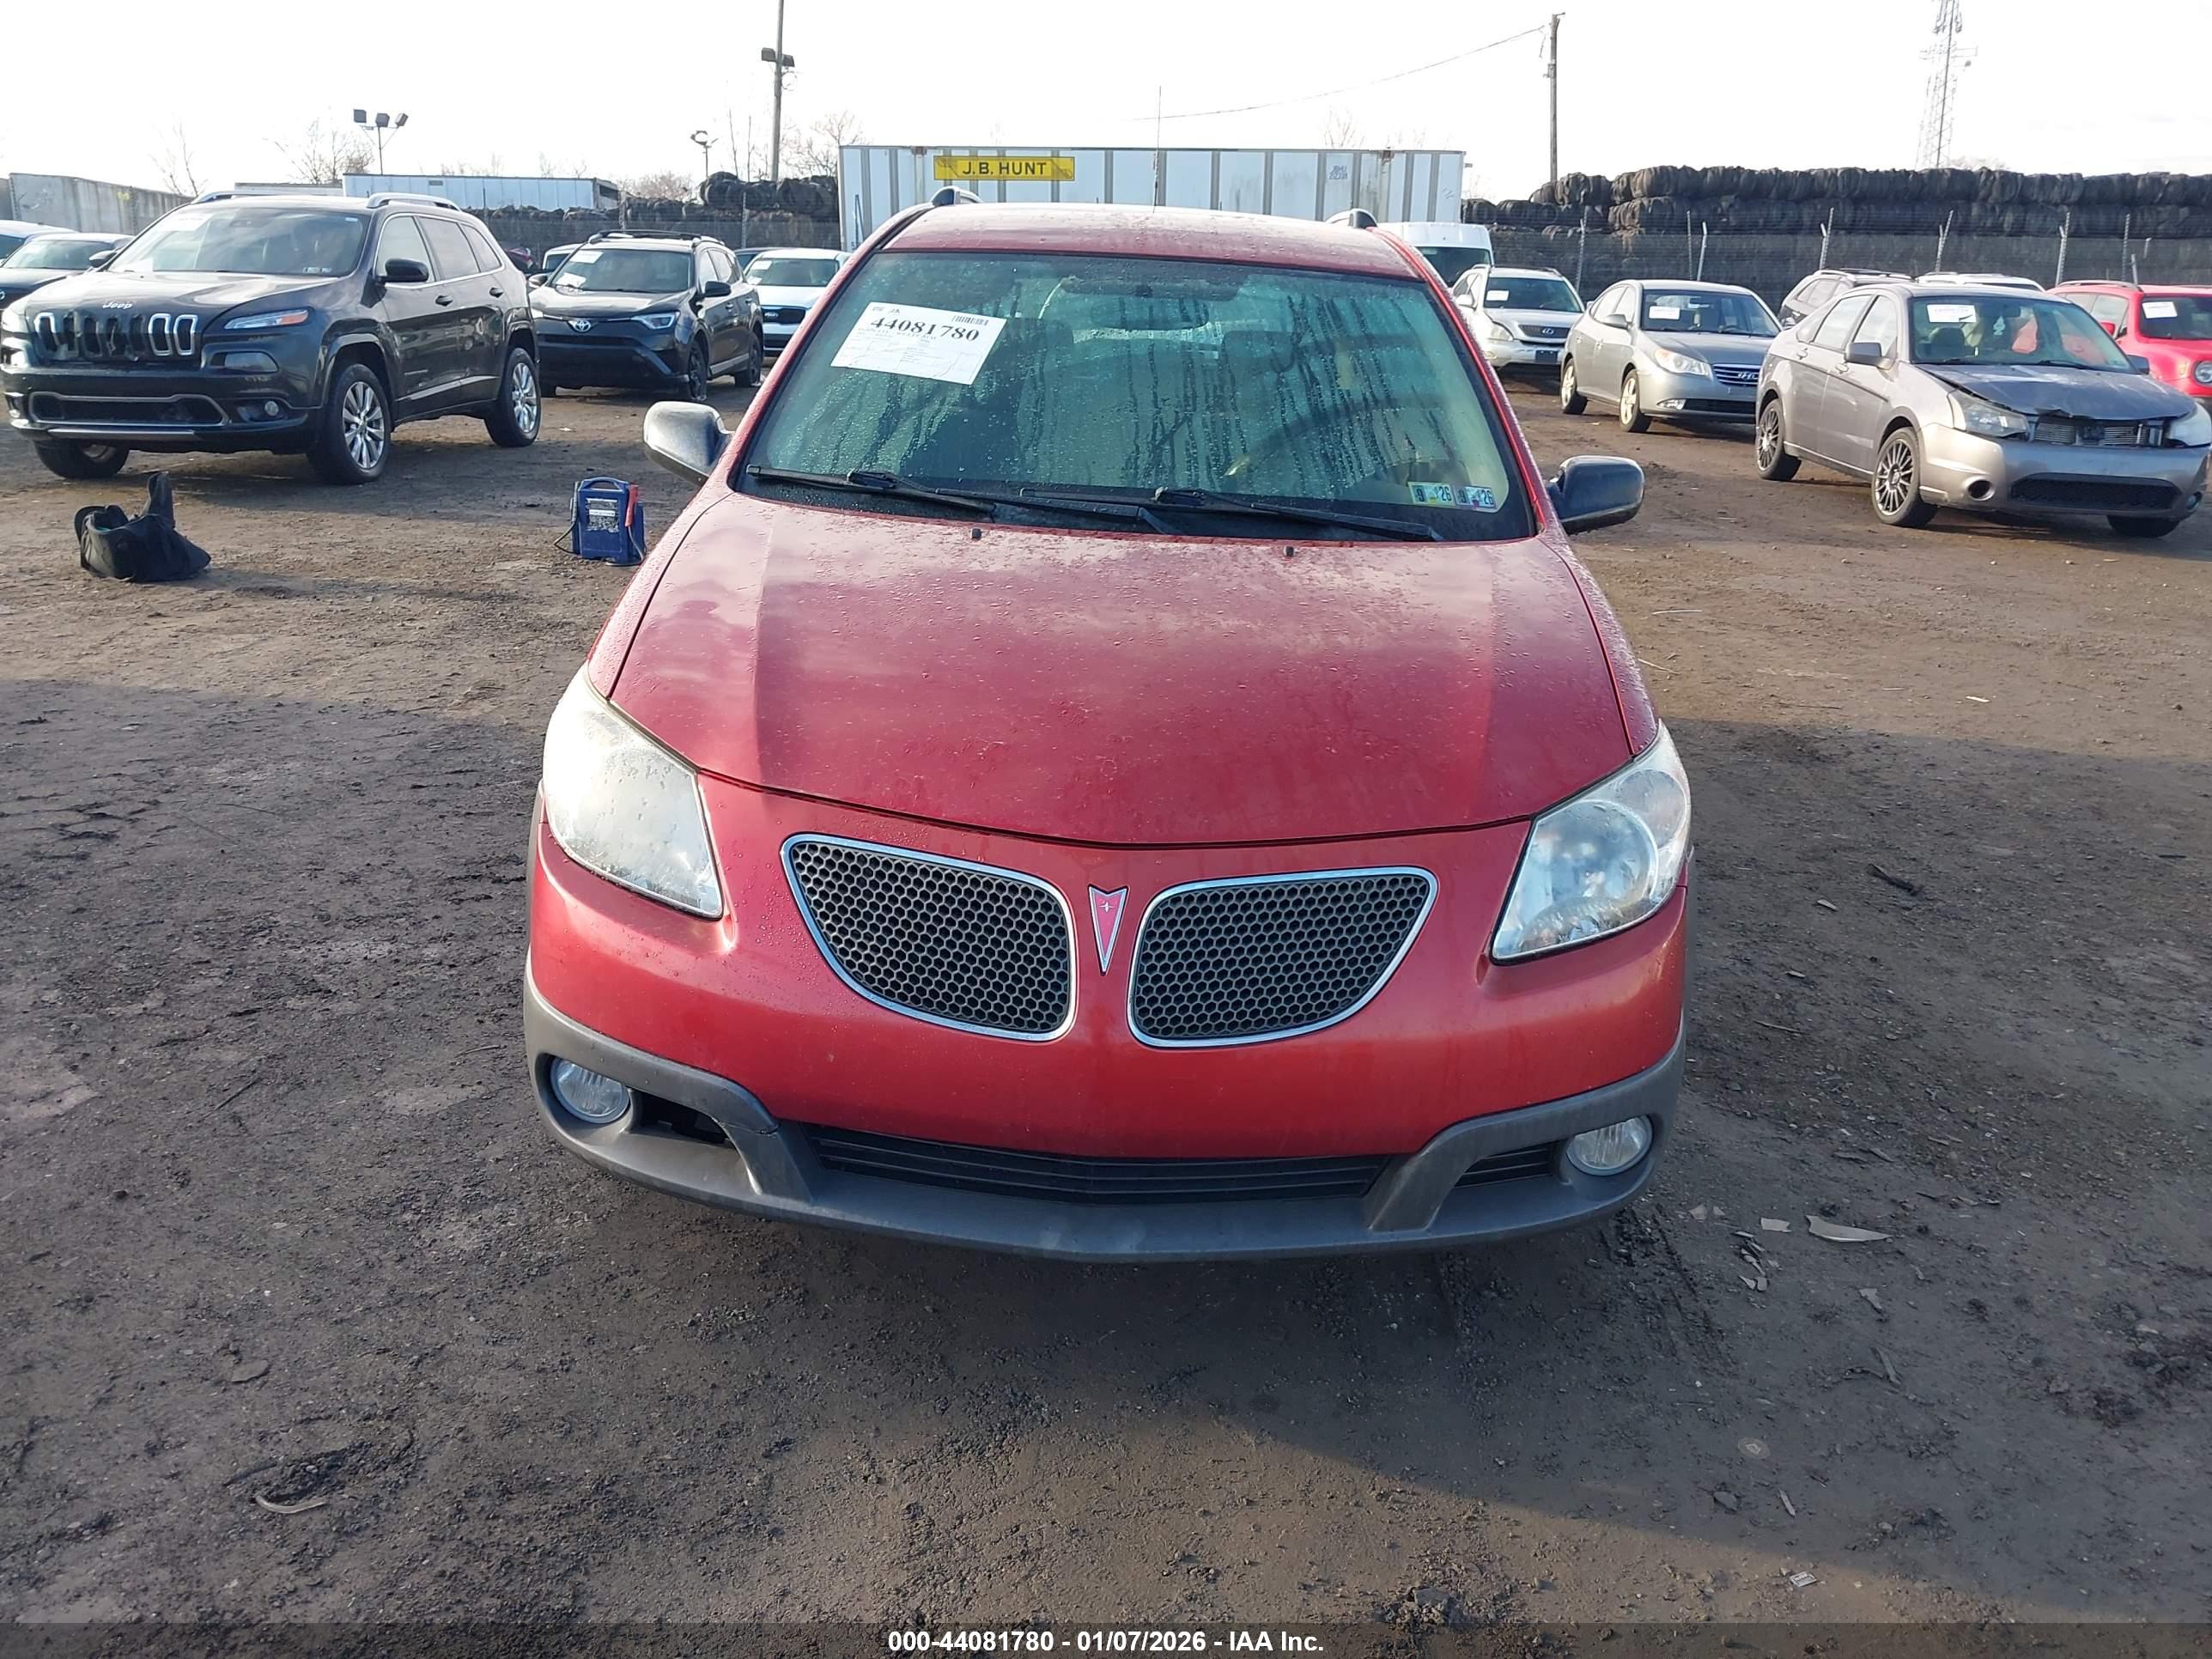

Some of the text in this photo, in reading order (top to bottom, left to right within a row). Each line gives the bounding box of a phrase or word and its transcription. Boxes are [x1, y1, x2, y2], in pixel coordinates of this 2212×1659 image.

[963, 161, 1048, 175] J.B. HUNT
[871, 317, 980, 342] 44081780
